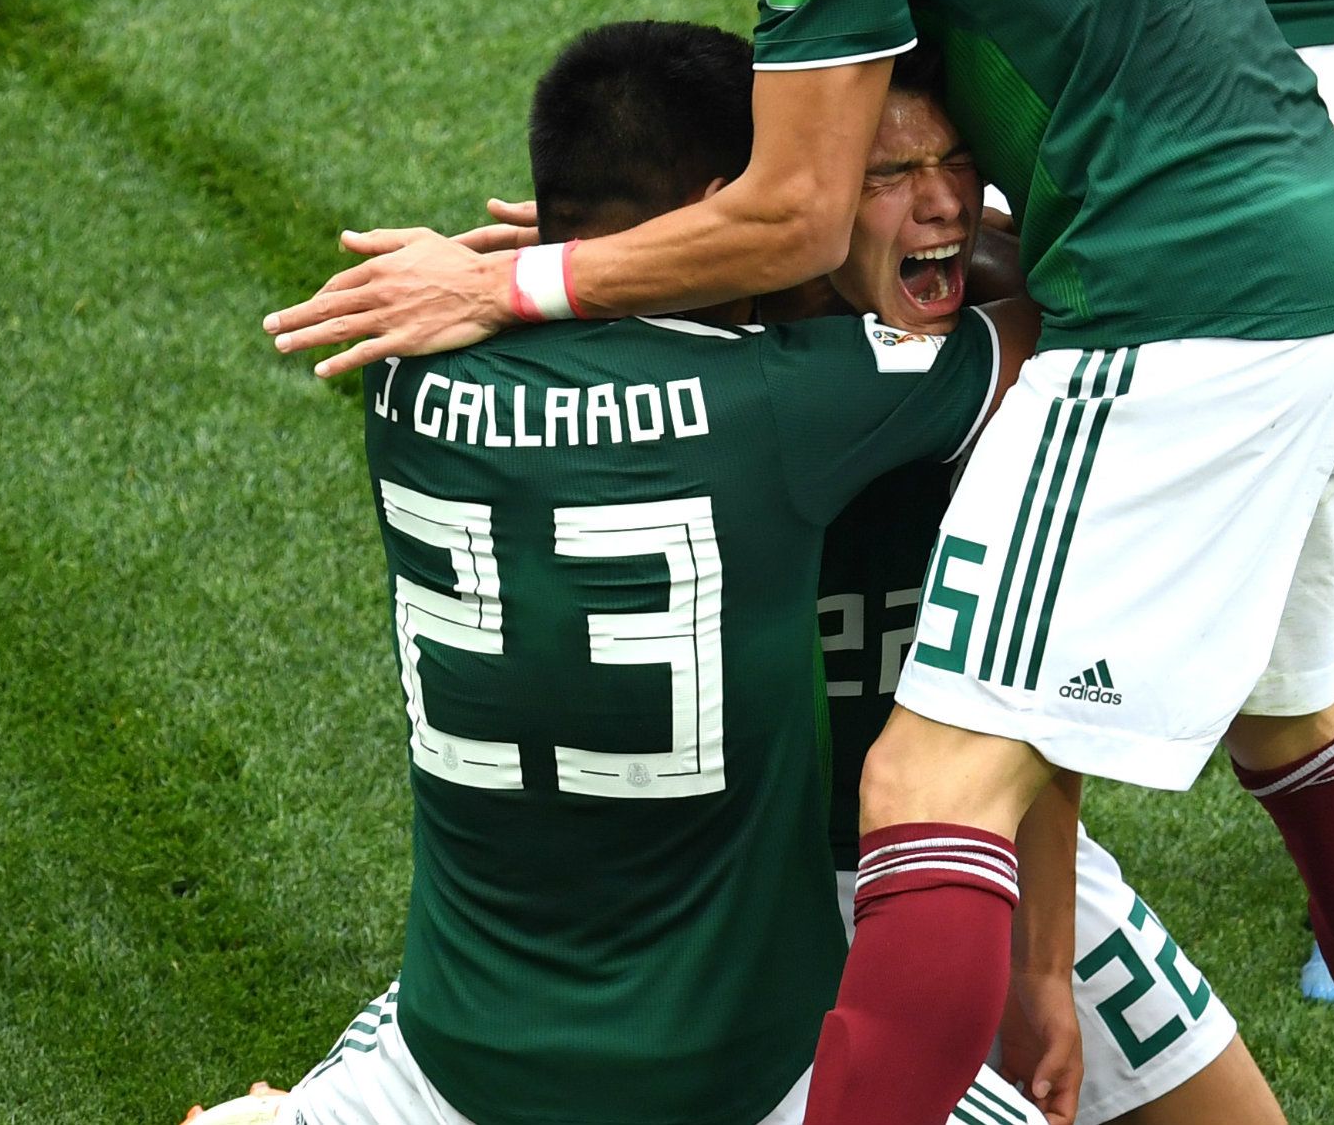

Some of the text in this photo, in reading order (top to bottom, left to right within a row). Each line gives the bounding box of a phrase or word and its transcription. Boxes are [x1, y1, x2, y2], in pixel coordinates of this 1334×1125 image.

[374, 356, 710, 448] J. GALLARDO
[378, 478, 727, 799] 23
[913, 528, 988, 675] 5
[1059, 685, 1123, 706] adidas
[1073, 894, 1211, 1071] 22
